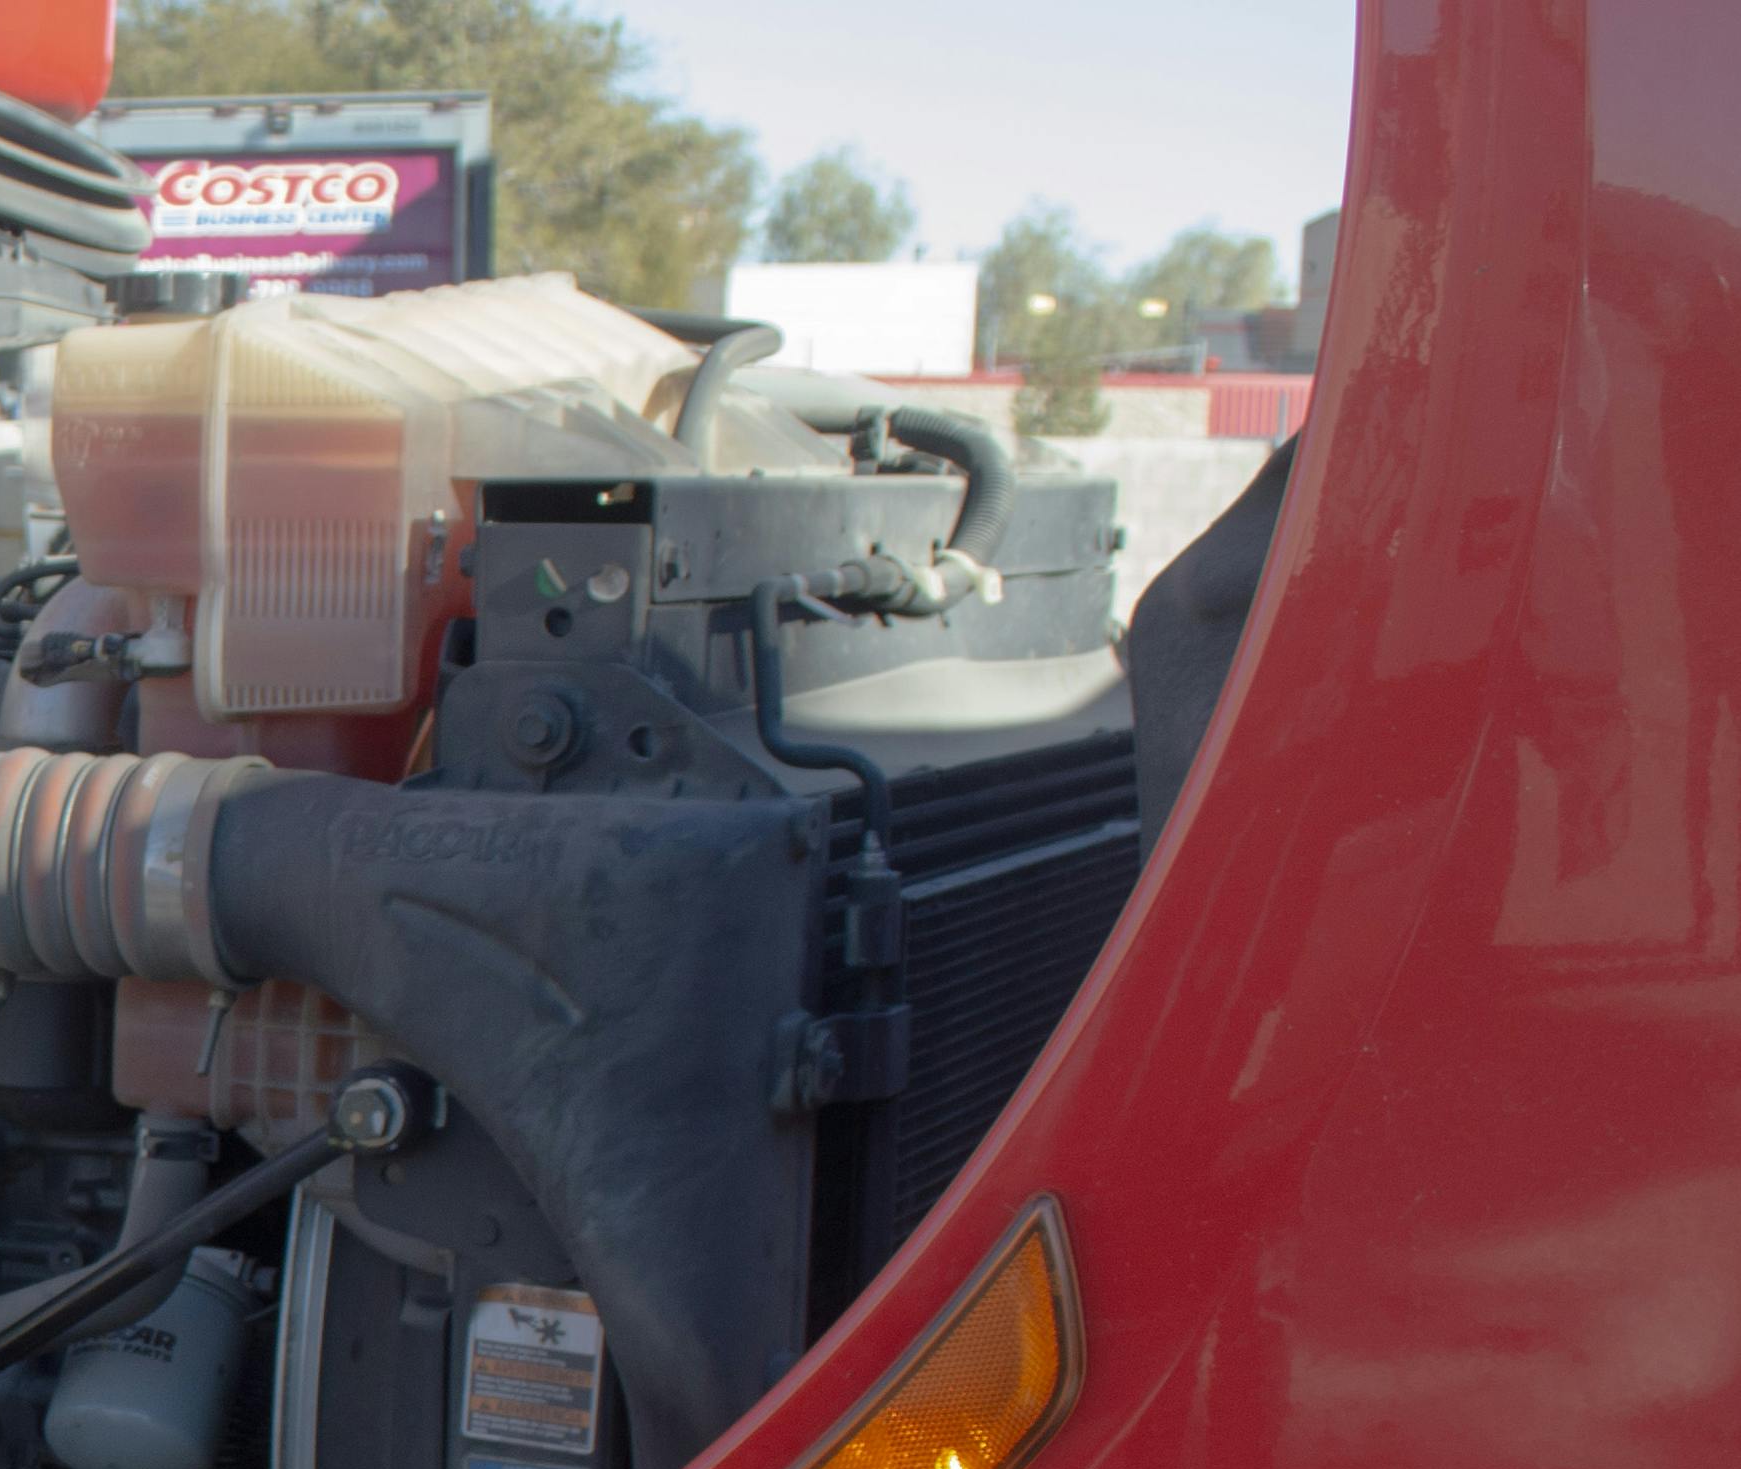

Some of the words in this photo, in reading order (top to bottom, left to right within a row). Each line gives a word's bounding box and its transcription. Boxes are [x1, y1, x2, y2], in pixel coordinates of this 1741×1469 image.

[160, 164, 388, 206] COSTCO
[195, 212, 295, 226] BUSINESS
[134, 252, 429, 276] ostcoBusinessDelivery.com
[122, 1343, 174, 1363] PARTS
